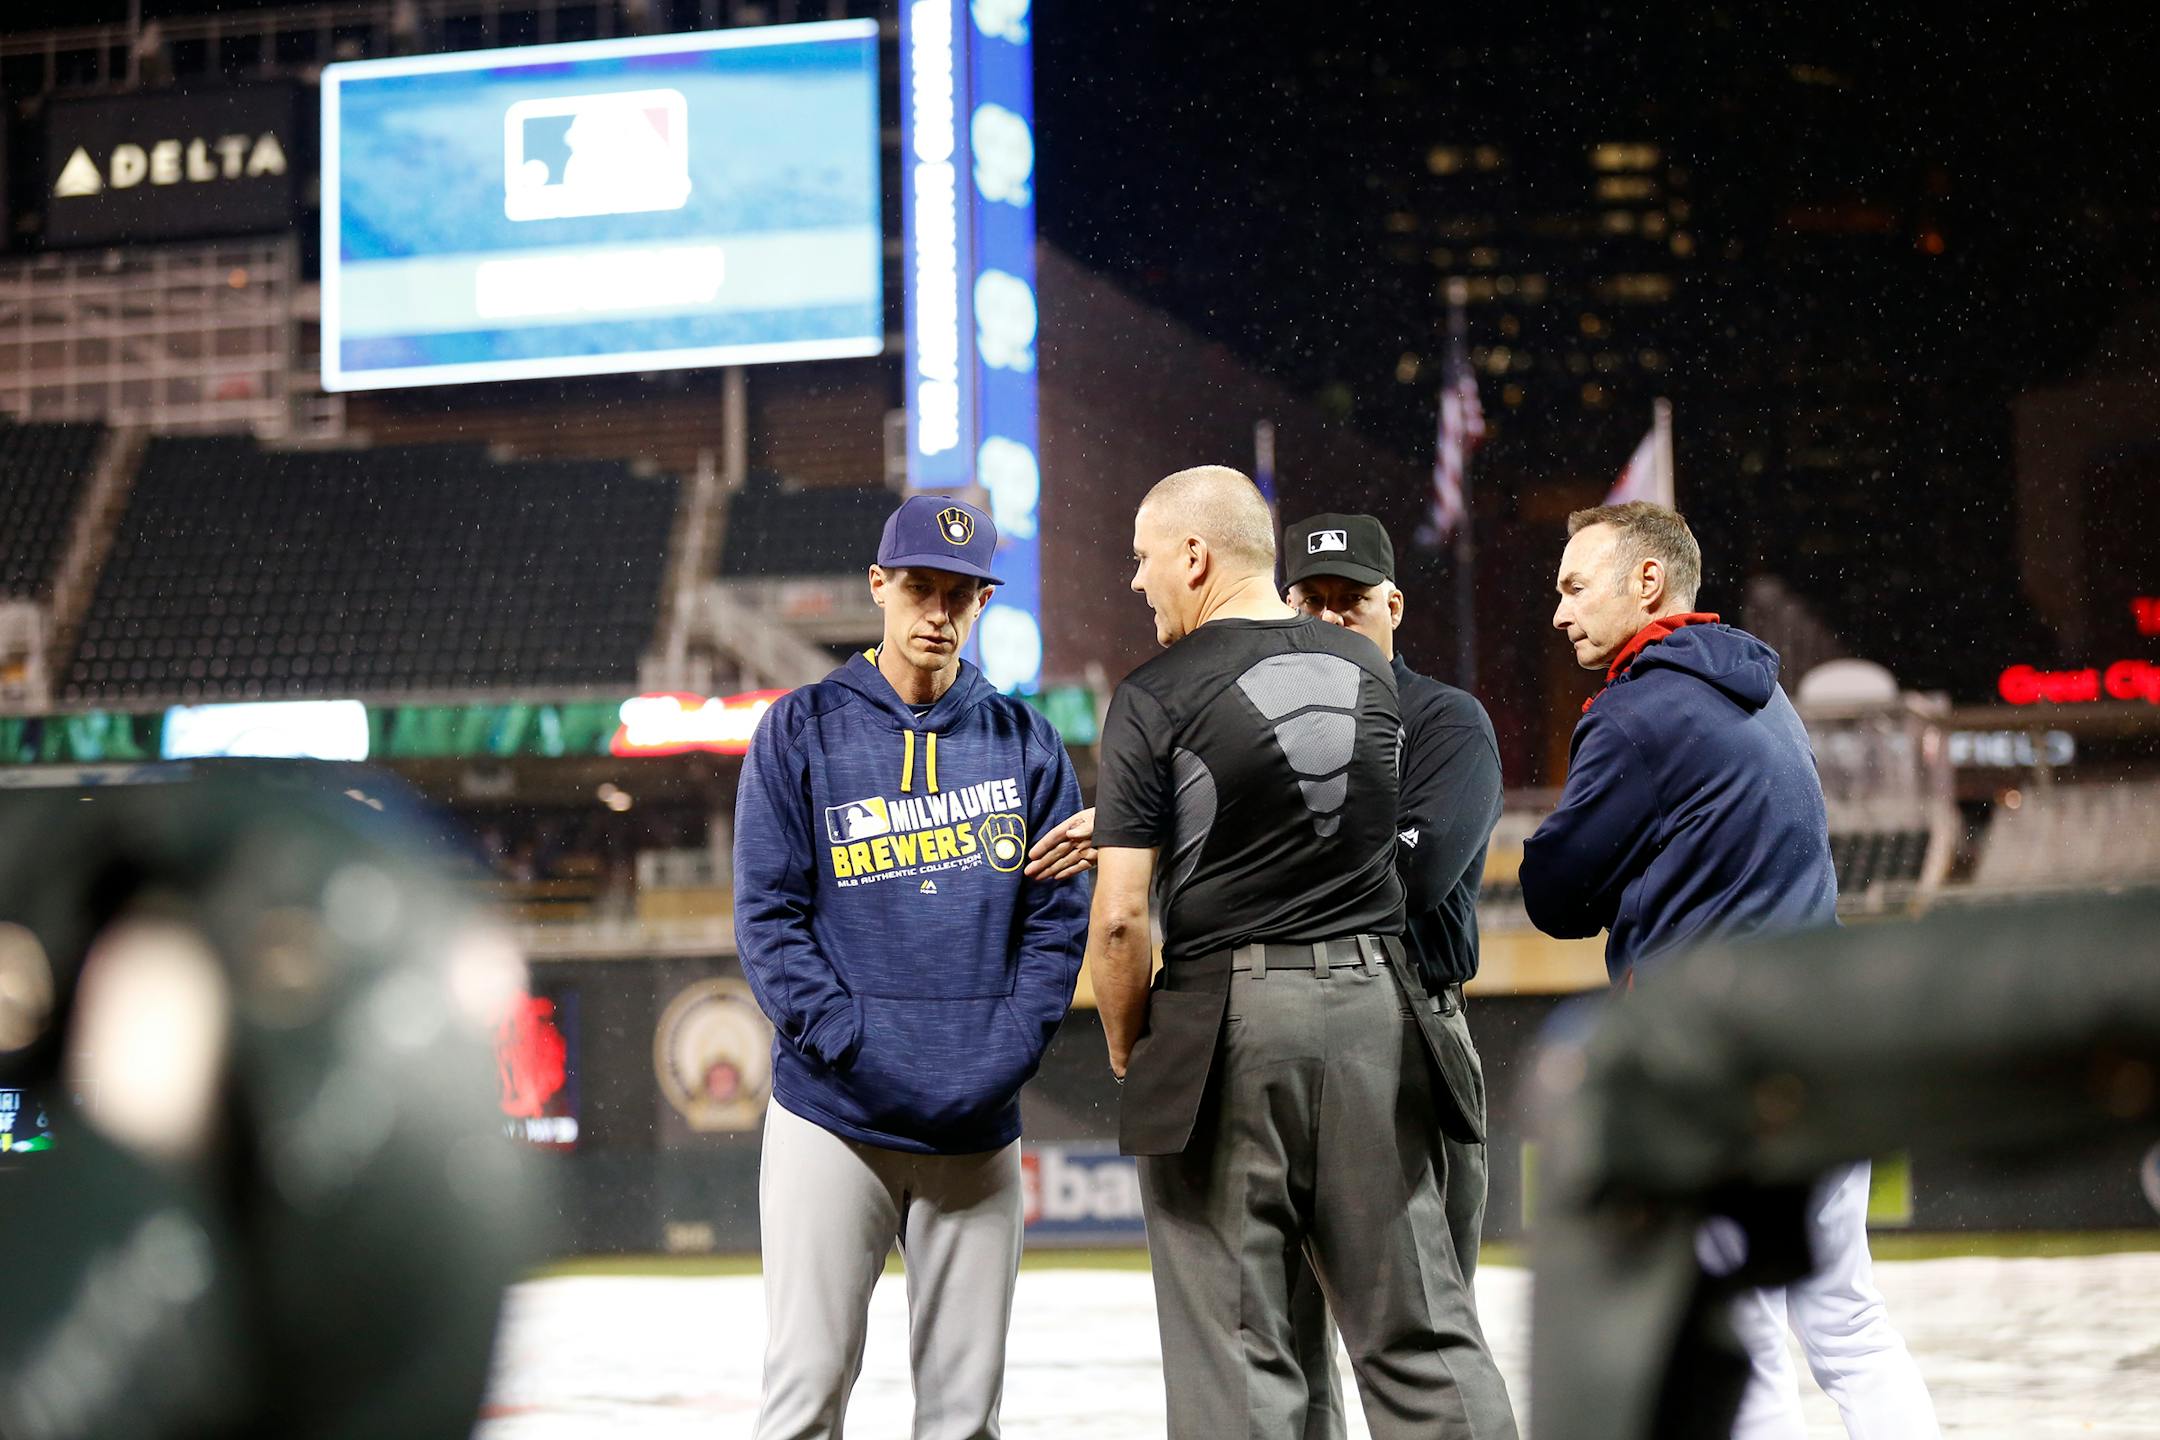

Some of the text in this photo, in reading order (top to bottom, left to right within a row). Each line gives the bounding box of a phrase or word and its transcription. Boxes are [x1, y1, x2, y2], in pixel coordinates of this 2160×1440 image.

[109, 131, 288, 189] DELTA
[887, 777, 1022, 833] MILWAUKEE
[830, 822, 977, 879] BREWERS
[837, 878, 859, 888] MLB
[860, 868, 918, 885] AUTHENTIC
[919, 853, 982, 874] COLLECTION
